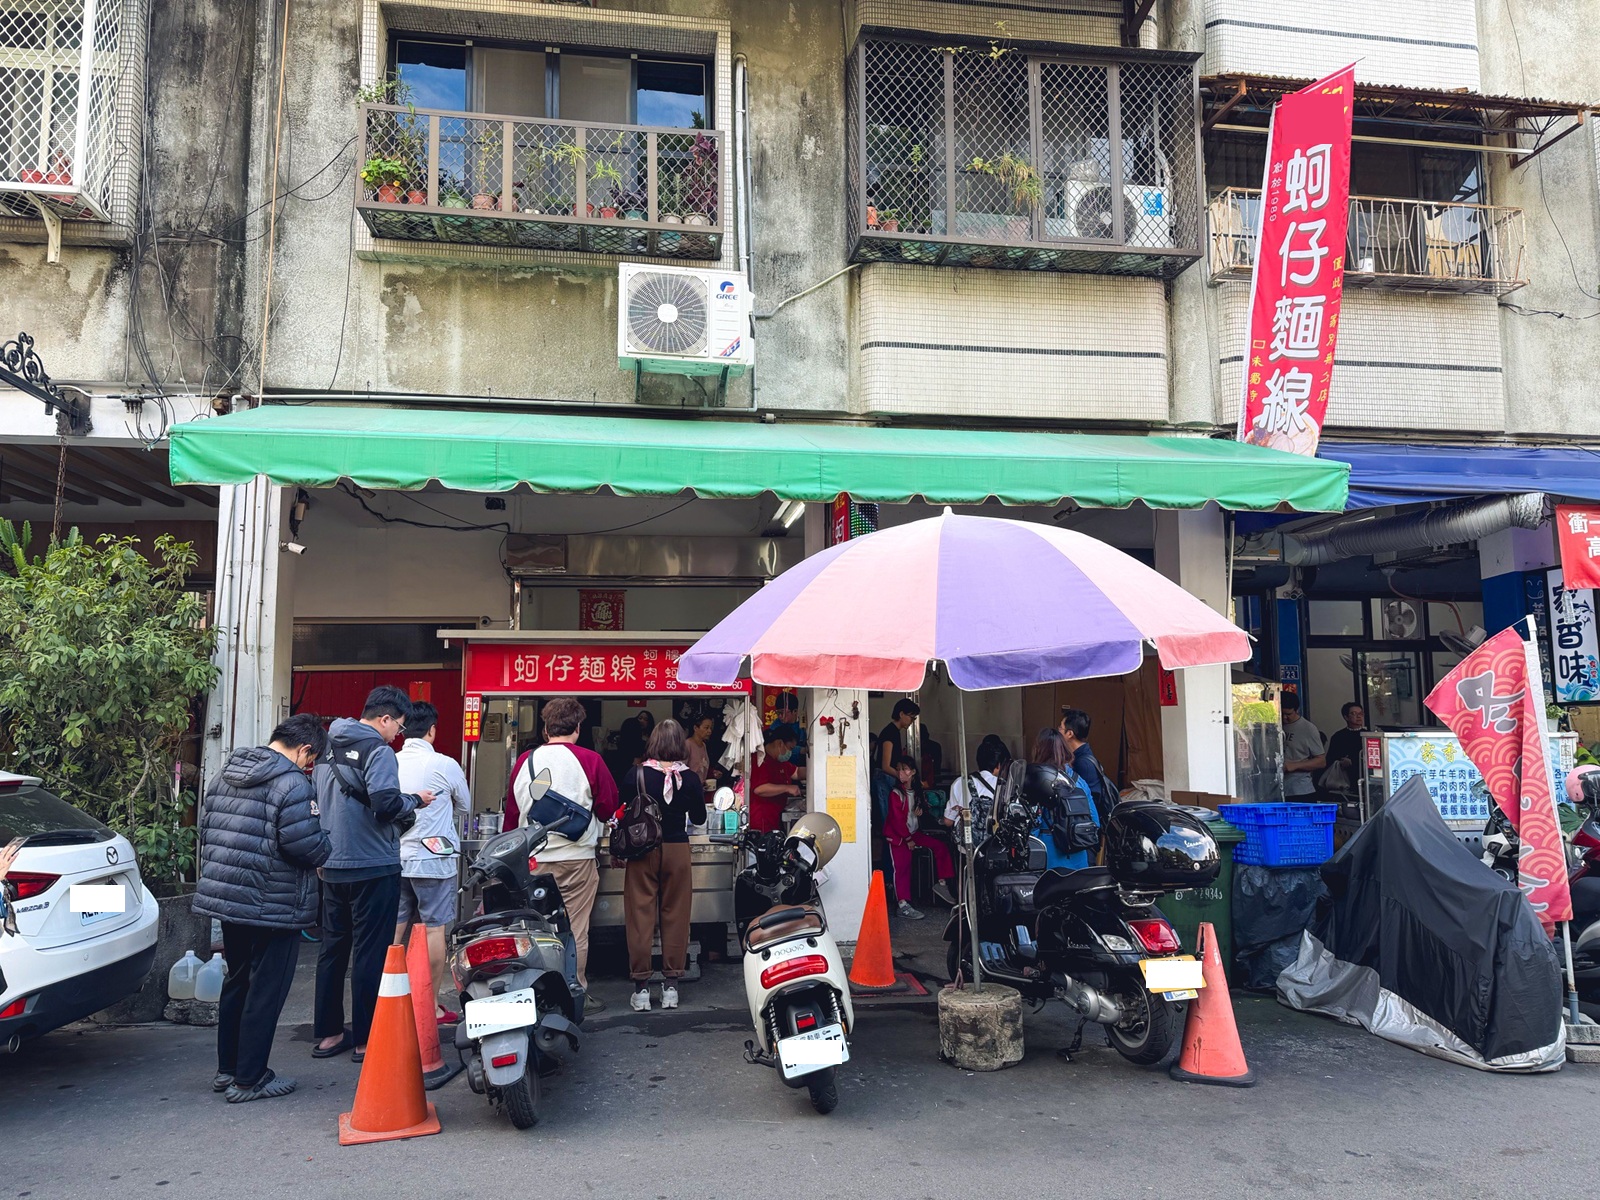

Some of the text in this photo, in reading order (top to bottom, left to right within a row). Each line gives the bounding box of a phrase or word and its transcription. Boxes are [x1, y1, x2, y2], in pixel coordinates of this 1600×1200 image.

[1259, 143, 1334, 435] 蚵仔麵線
[513, 653, 637, 683] 蚵仔麵線
[644, 680, 656, 689] 55
[665, 680, 677, 689] 55
